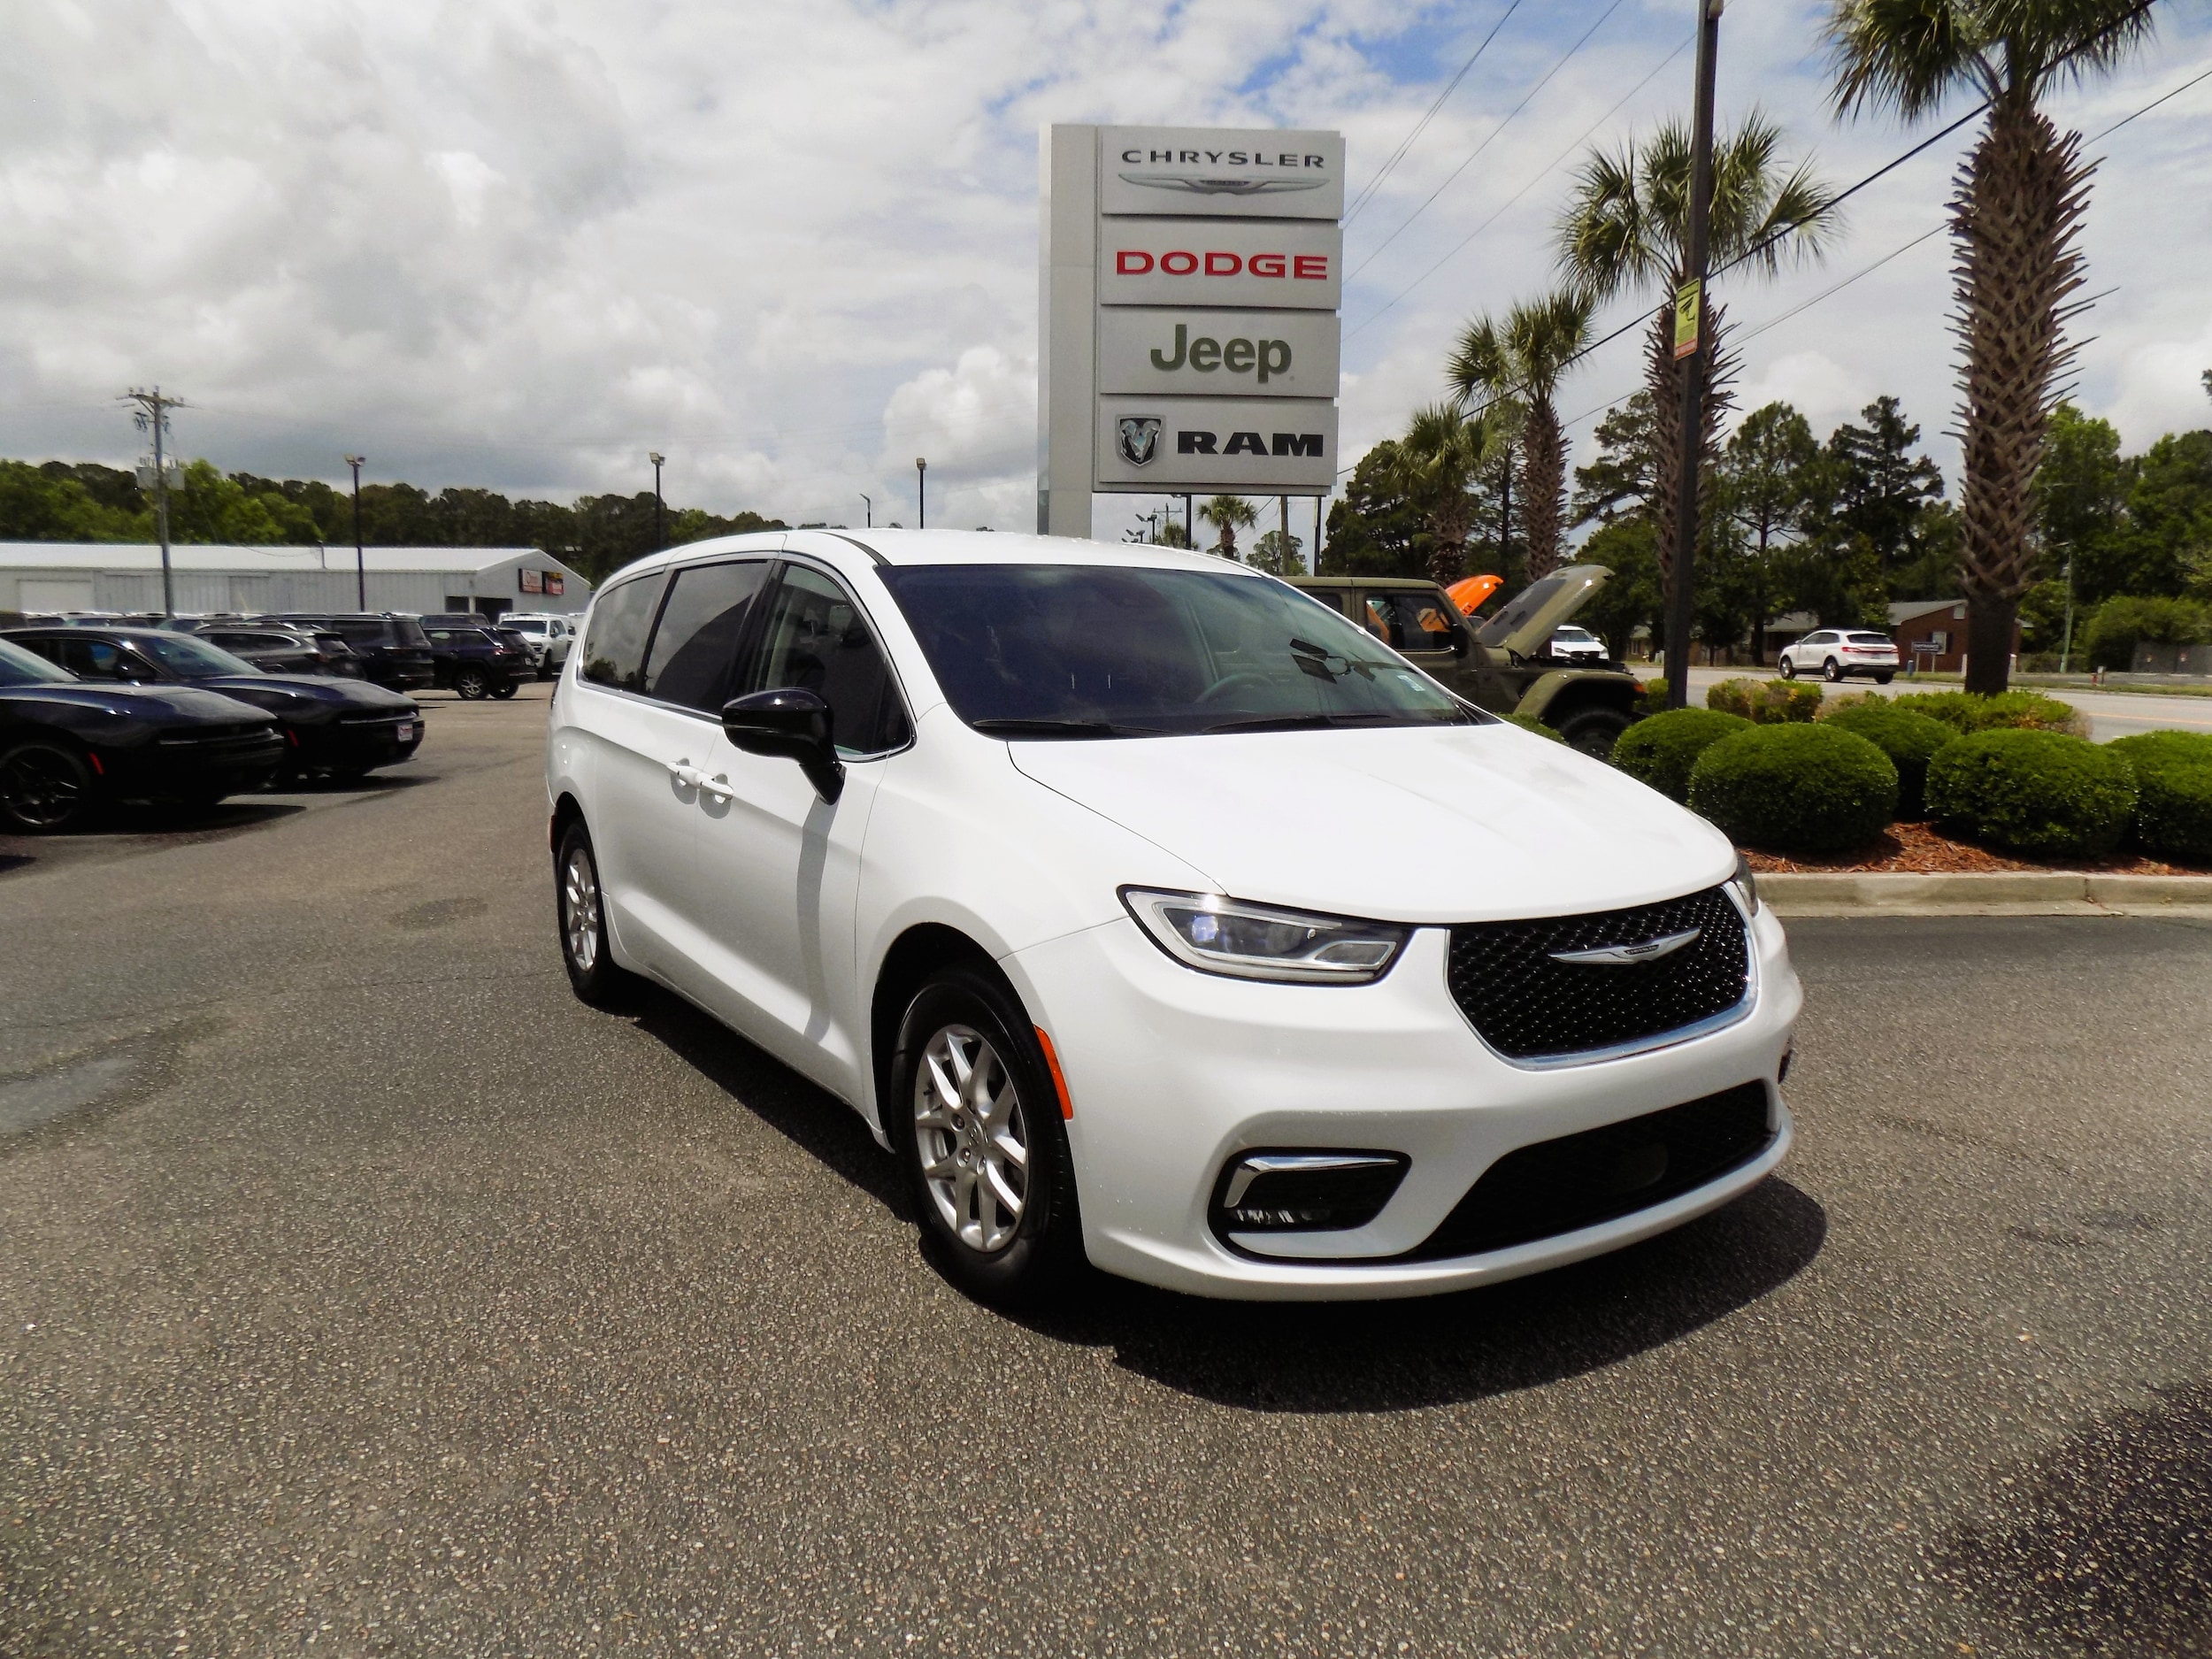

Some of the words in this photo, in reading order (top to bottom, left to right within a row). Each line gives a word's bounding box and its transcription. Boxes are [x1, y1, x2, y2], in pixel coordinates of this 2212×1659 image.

[1121, 150, 1325, 168] CHRYSLER
[1117, 250, 1327, 280] DODGE
[1150, 324, 1292, 383] Jeep
[1178, 431, 1324, 457] RAM
